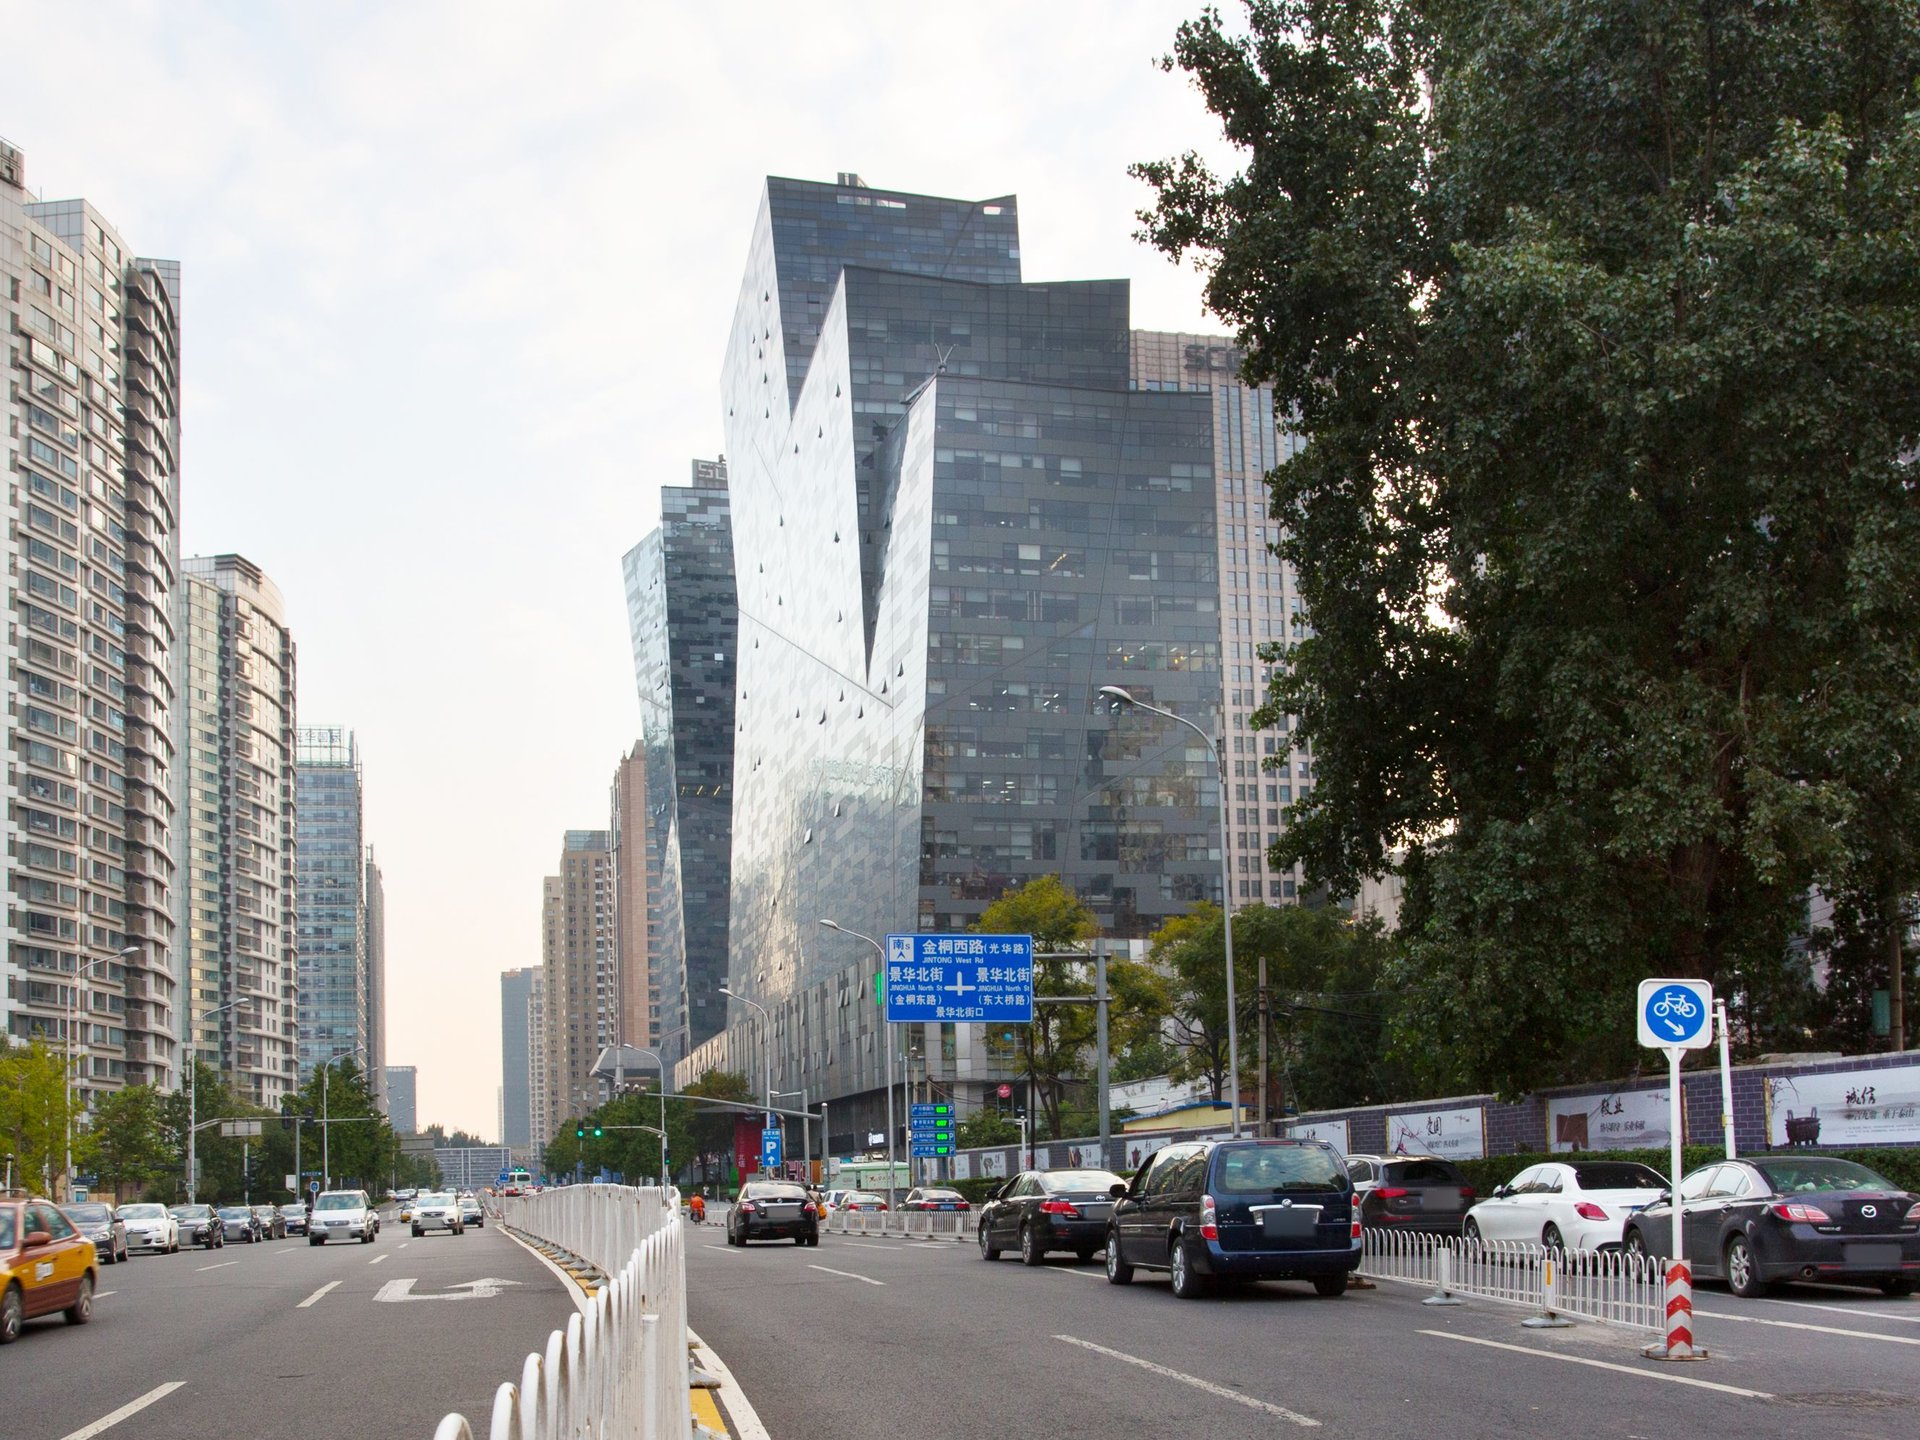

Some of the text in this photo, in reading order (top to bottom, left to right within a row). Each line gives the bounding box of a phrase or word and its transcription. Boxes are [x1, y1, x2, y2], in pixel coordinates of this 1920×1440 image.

[893, 939, 904, 950] 南
[889, 967, 943, 982] 景华北街
[976, 967, 1030, 983] 景华北街
[936, 1007, 984, 1018] 景华北街口
[1845, 1086, 1876, 1105] 诚信
[766, 1141, 777, 1154] P
